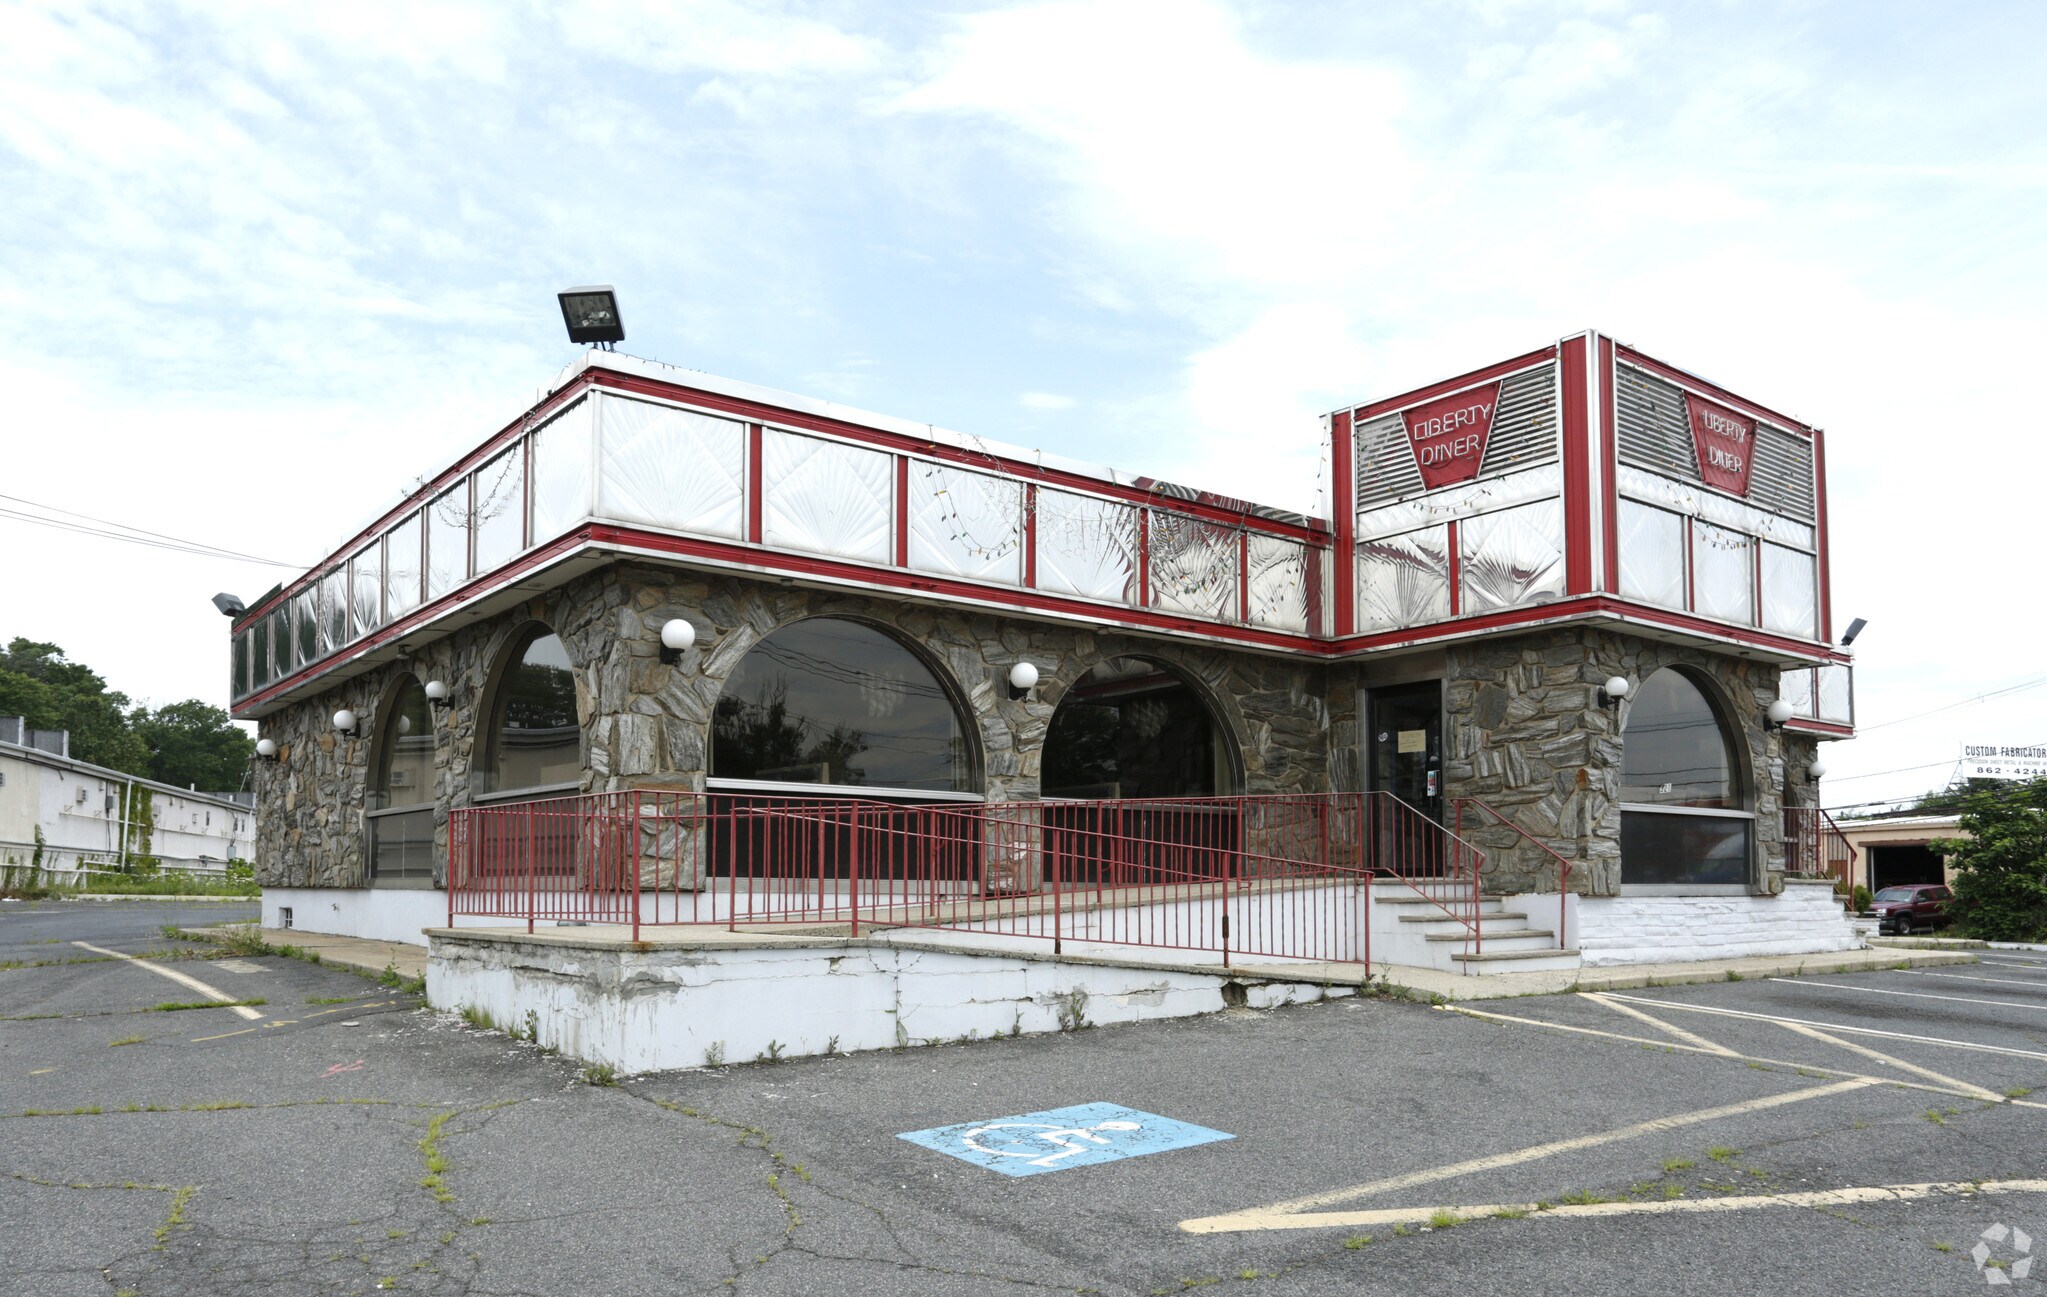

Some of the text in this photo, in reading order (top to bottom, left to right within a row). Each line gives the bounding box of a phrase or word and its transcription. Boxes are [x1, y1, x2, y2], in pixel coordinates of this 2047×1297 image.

[1414, 403, 1492, 440] LIBERTY
[1703, 410, 1747, 443] LIBERTY
[1421, 434, 1481, 466] DINER
[1708, 446, 1743, 473] DINER
[1965, 745, 1997, 757] CUSTOM
